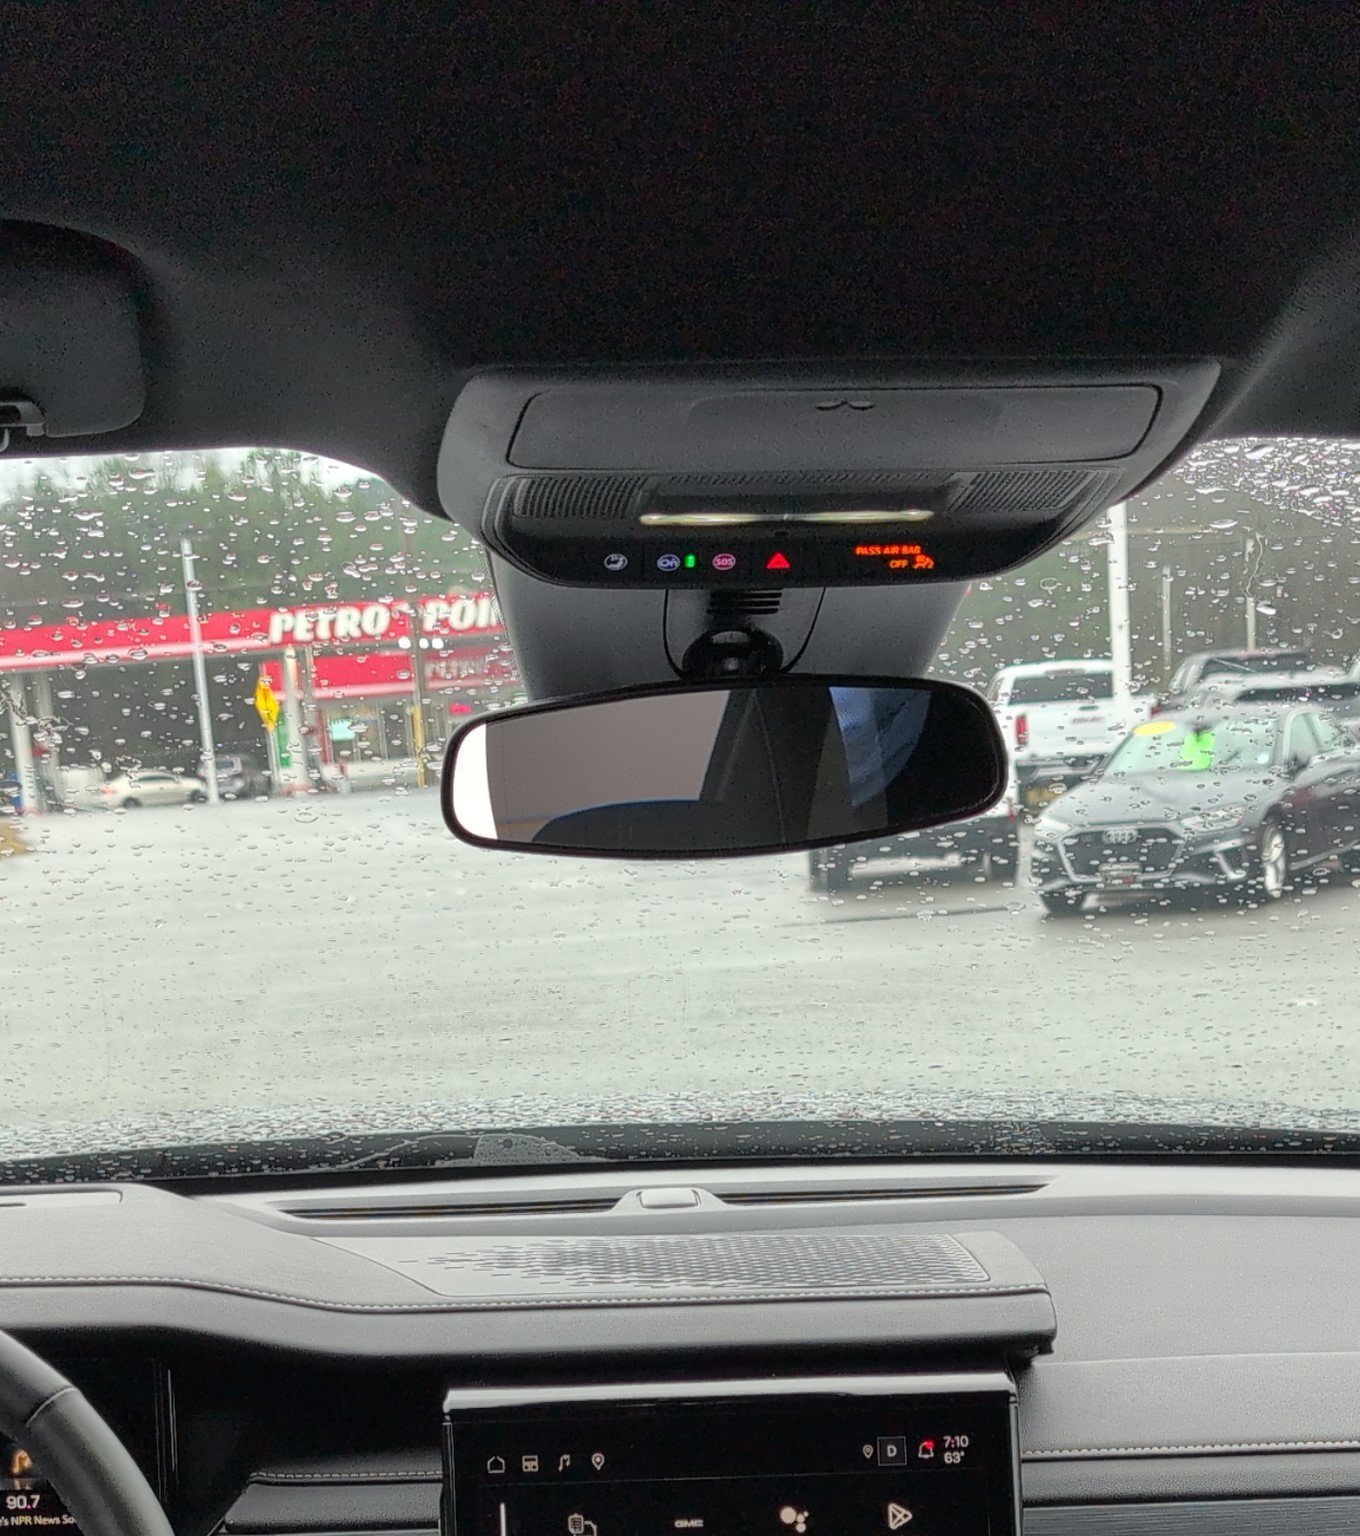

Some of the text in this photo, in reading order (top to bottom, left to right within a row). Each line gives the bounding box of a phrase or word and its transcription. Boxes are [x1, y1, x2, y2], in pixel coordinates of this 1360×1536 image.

[855, 545, 922, 555] PASS AIR BAG
[716, 557, 733, 567] SOS
[890, 560, 908, 568] OFF
[268, 604, 391, 644] PETRO
[942, 1435, 969, 1449] 7:10
[5, 1494, 41, 1510] 90.7
[10, 1514, 33, 1527] NPR
[33, 1514, 61, 1526] News
[674, 1518, 704, 1528] GMC
